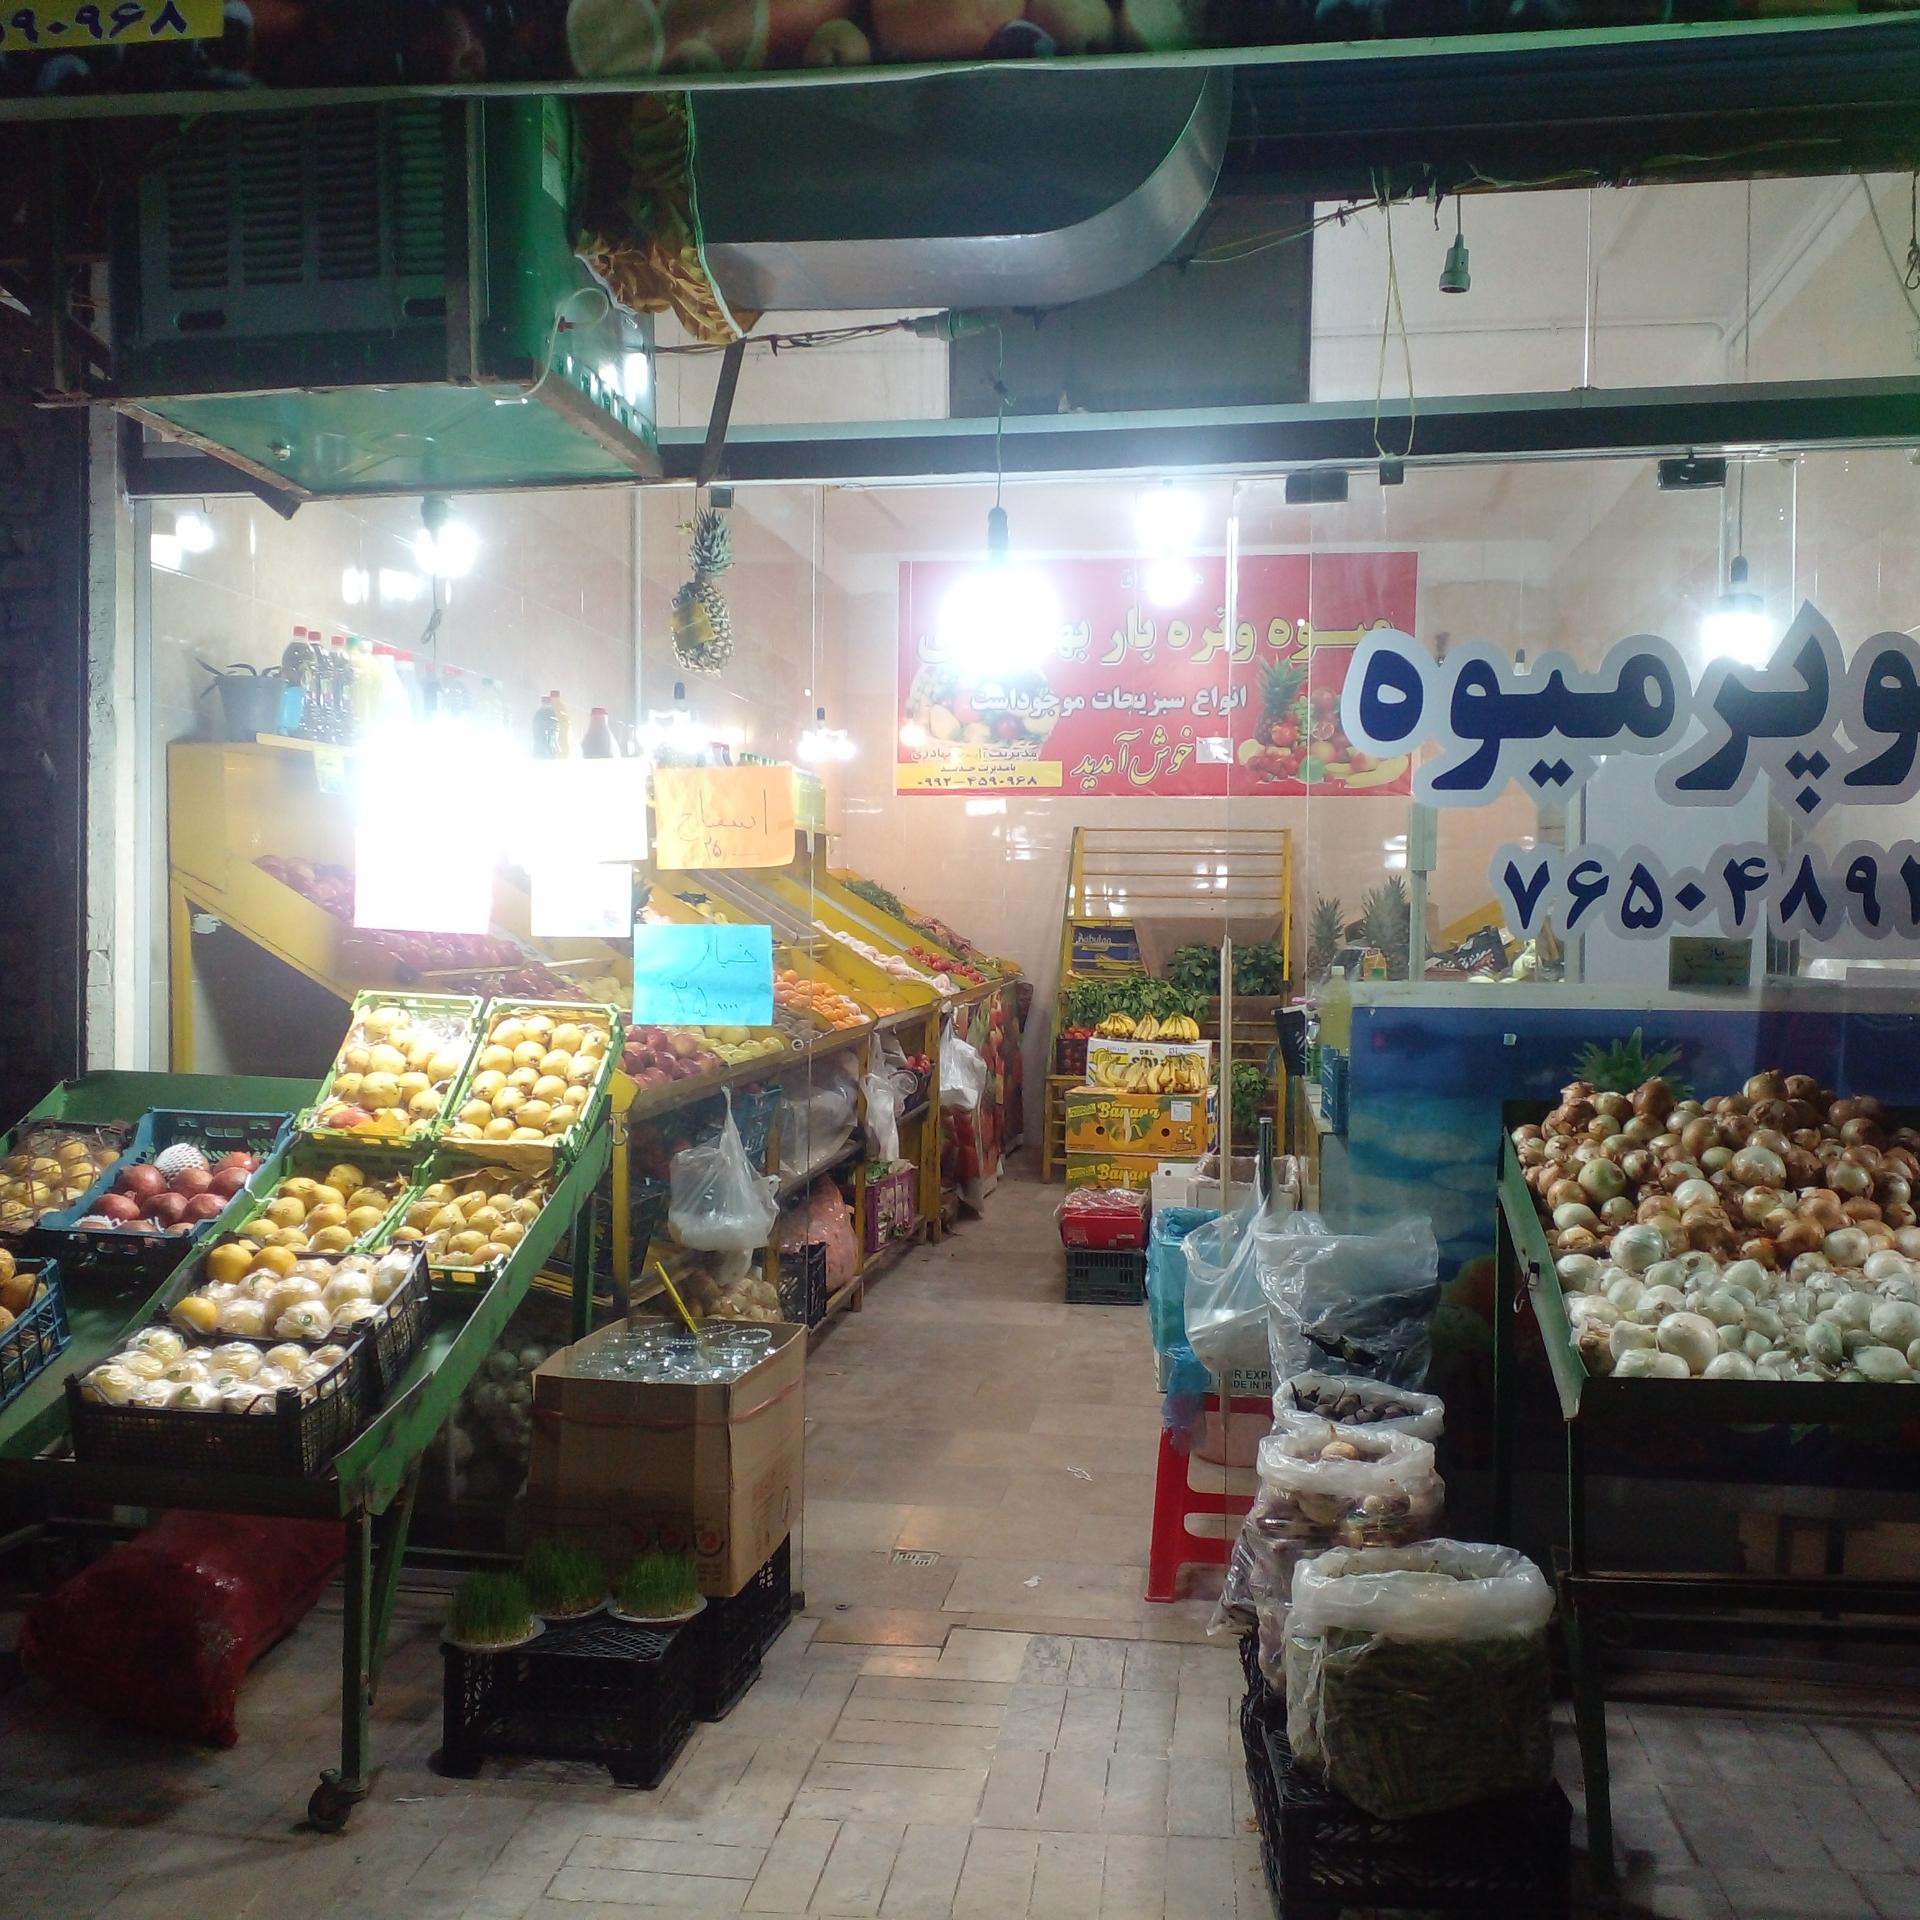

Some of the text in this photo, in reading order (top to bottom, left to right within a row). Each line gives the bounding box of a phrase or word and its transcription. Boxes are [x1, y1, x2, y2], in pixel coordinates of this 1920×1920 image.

[1101, 606, 1156, 662] بار
[1091, 686, 1185, 716] سبزیجات
[1190, 686, 1247, 715] انواع
[1071, 725, 1195, 790] خوش آمدید
